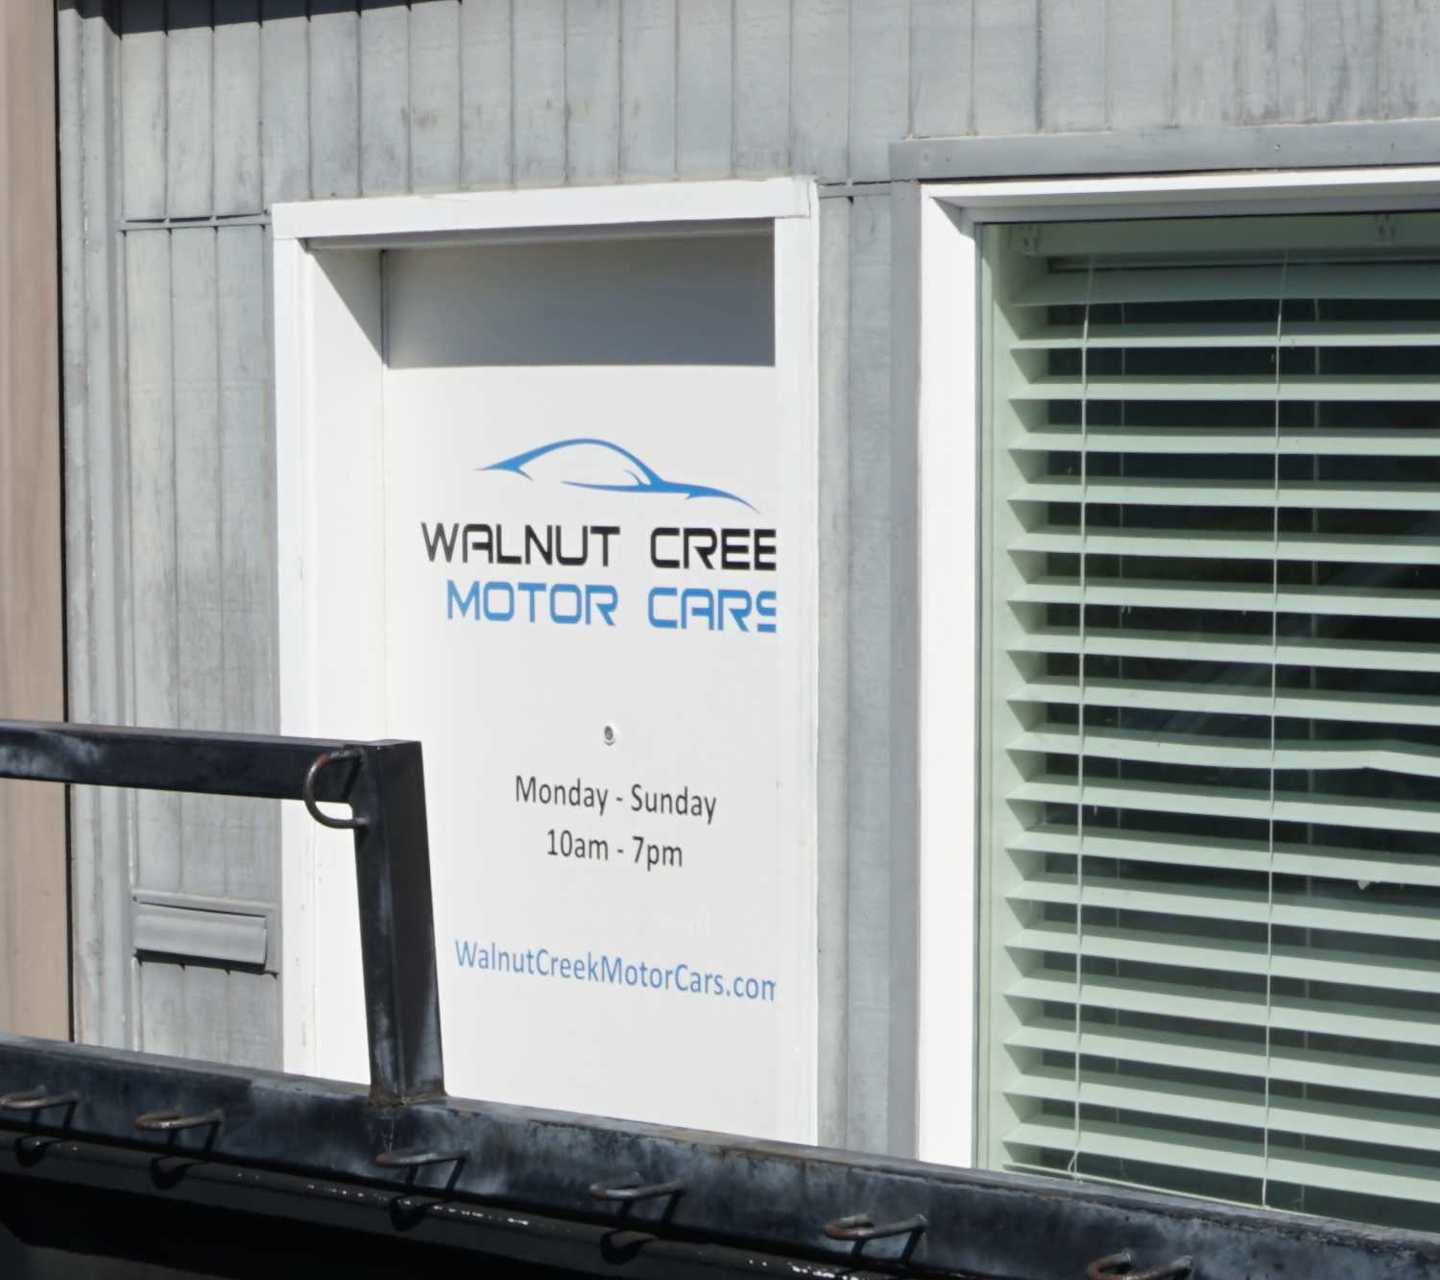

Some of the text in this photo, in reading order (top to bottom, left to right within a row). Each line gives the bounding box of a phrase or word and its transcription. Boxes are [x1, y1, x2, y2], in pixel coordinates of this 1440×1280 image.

[420, 522, 620, 567] WALNUT
[446, 579, 776, 633] MOTOR CARS
[515, 775, 609, 817] Monday
[631, 783, 717, 825] Sunday
[547, 828, 609, 861] 10am
[632, 835, 683, 872] 7pm
